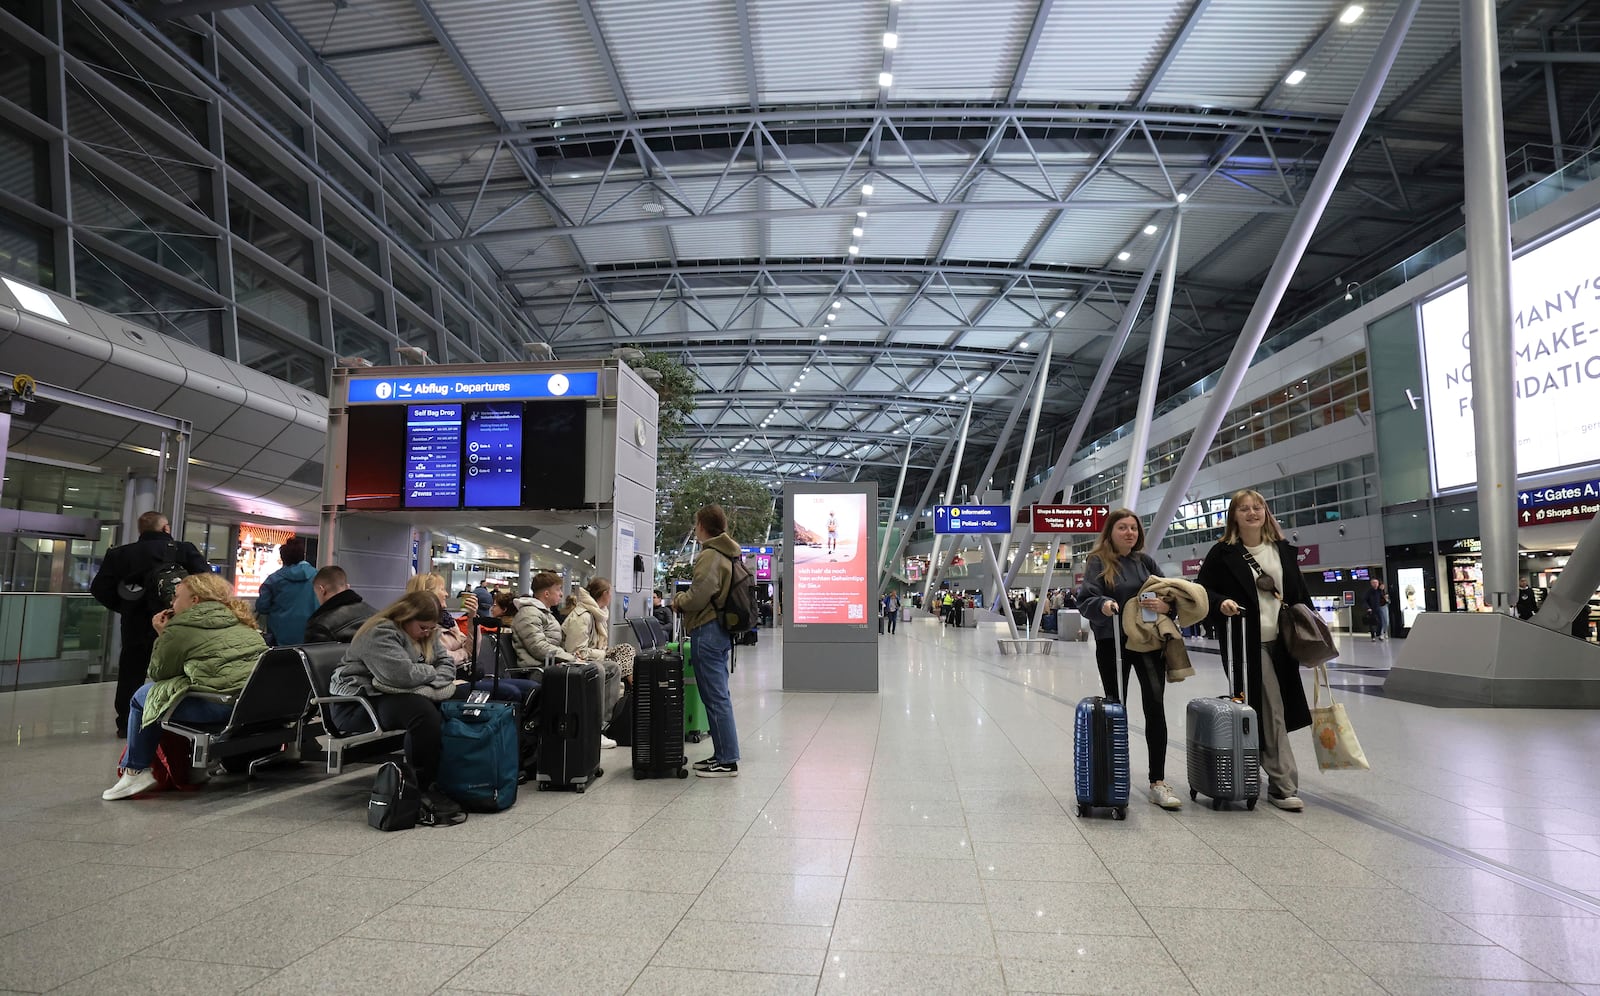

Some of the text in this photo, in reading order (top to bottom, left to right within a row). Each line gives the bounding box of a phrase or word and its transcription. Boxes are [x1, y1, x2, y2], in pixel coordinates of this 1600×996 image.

[414, 382, 511, 396] Abflug Departures
[1459, 355, 1600, 417] FDATIO
[414, 409, 455, 418] Self Bag Drop
[1545, 482, 1600, 501] Gates A,
[1546, 503, 1600, 518] Shops & Rest
